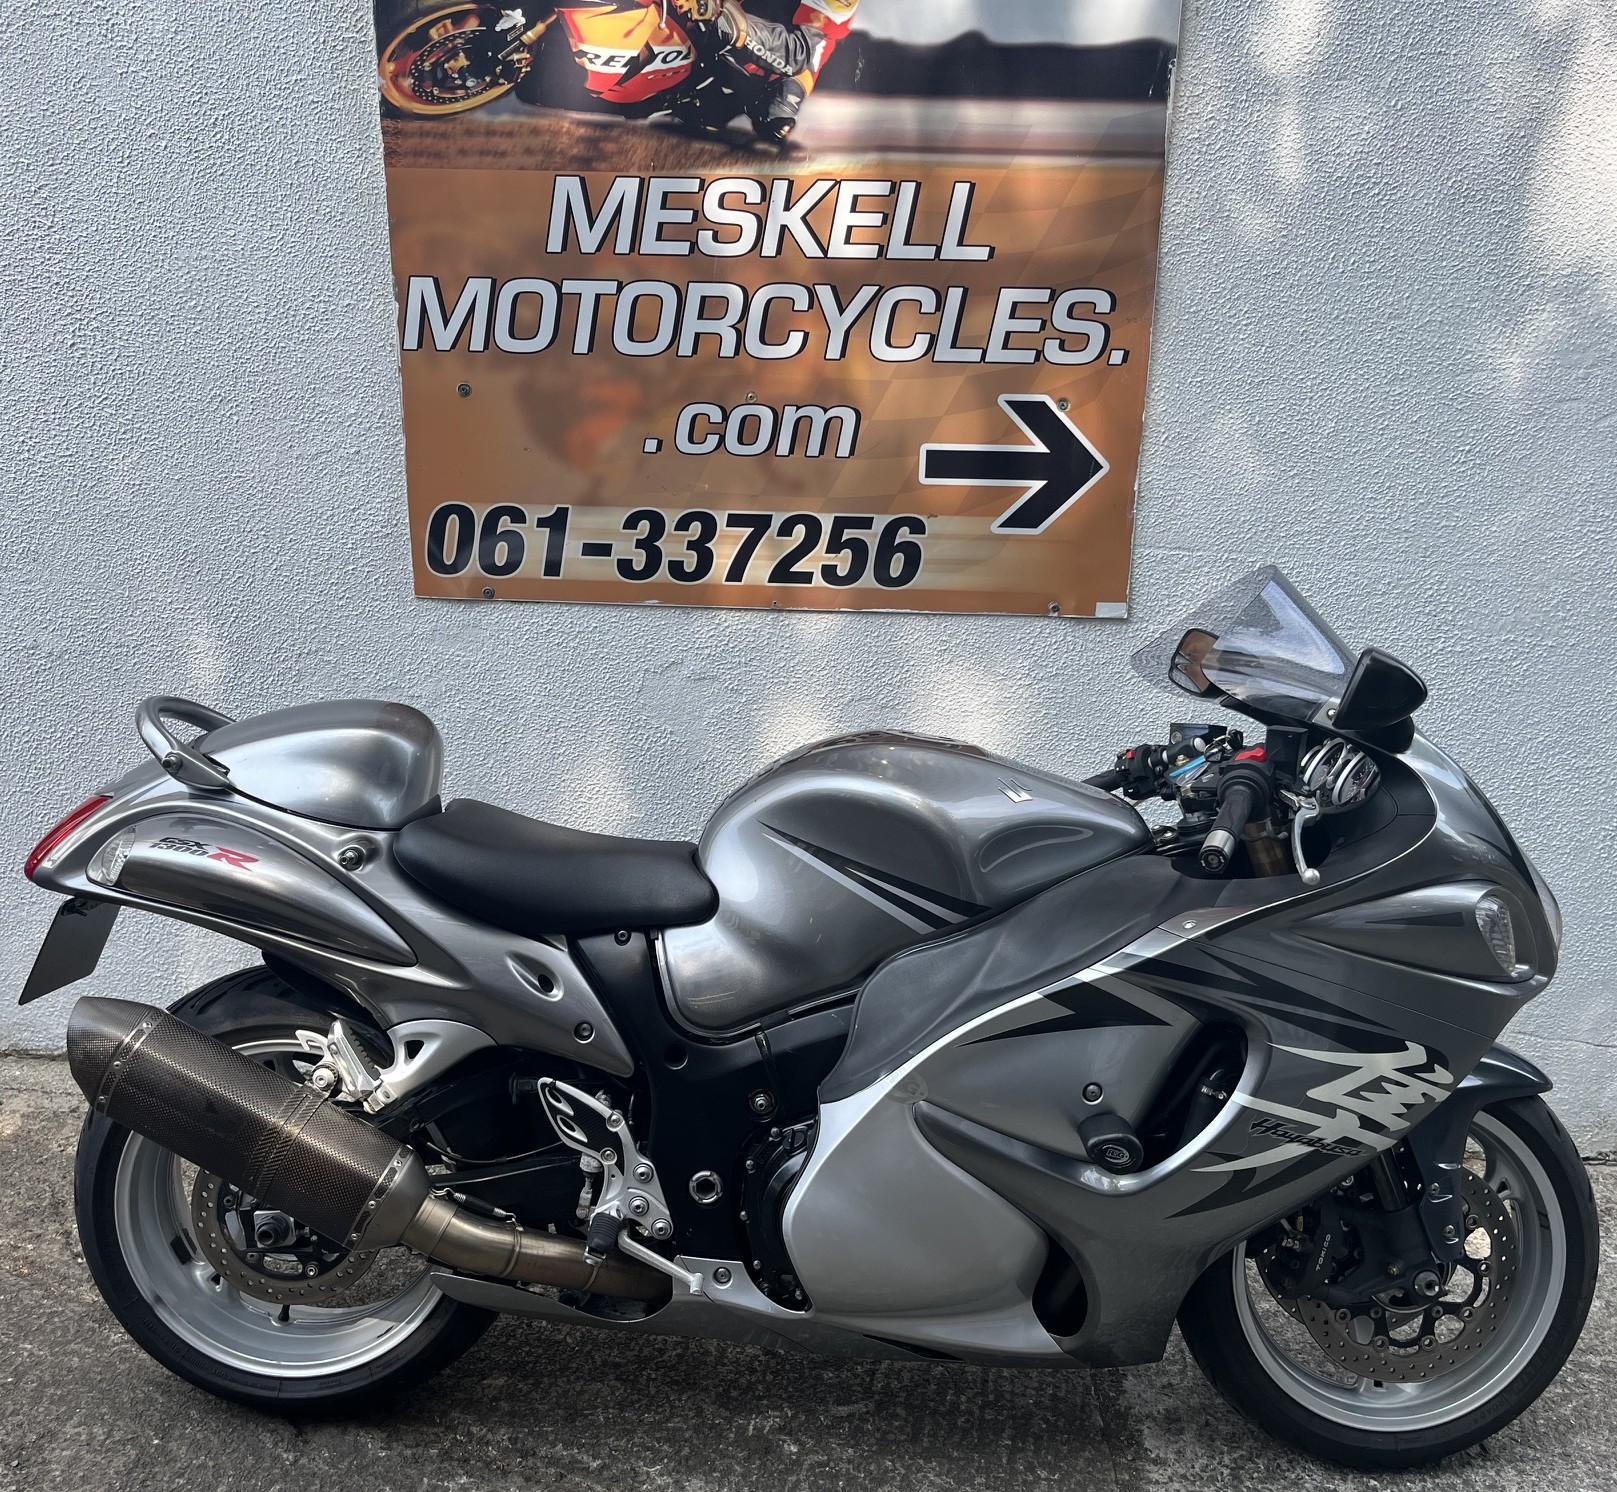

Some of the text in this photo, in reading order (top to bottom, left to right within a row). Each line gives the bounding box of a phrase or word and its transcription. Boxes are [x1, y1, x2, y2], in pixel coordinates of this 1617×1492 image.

[744, 35, 794, 76] HONDA
[545, 175, 994, 263] MESKELL
[402, 275, 1130, 367] MOTORCYCLES.
[643, 402, 860, 459] .com
[426, 502, 928, 588] 061-337256
[149, 842, 260, 872] 1300 R
[159, 836, 212, 851] GSX
[1250, 1117, 1364, 1157] Hayabusa
[1315, 1233, 1331, 1271] TOKICO
